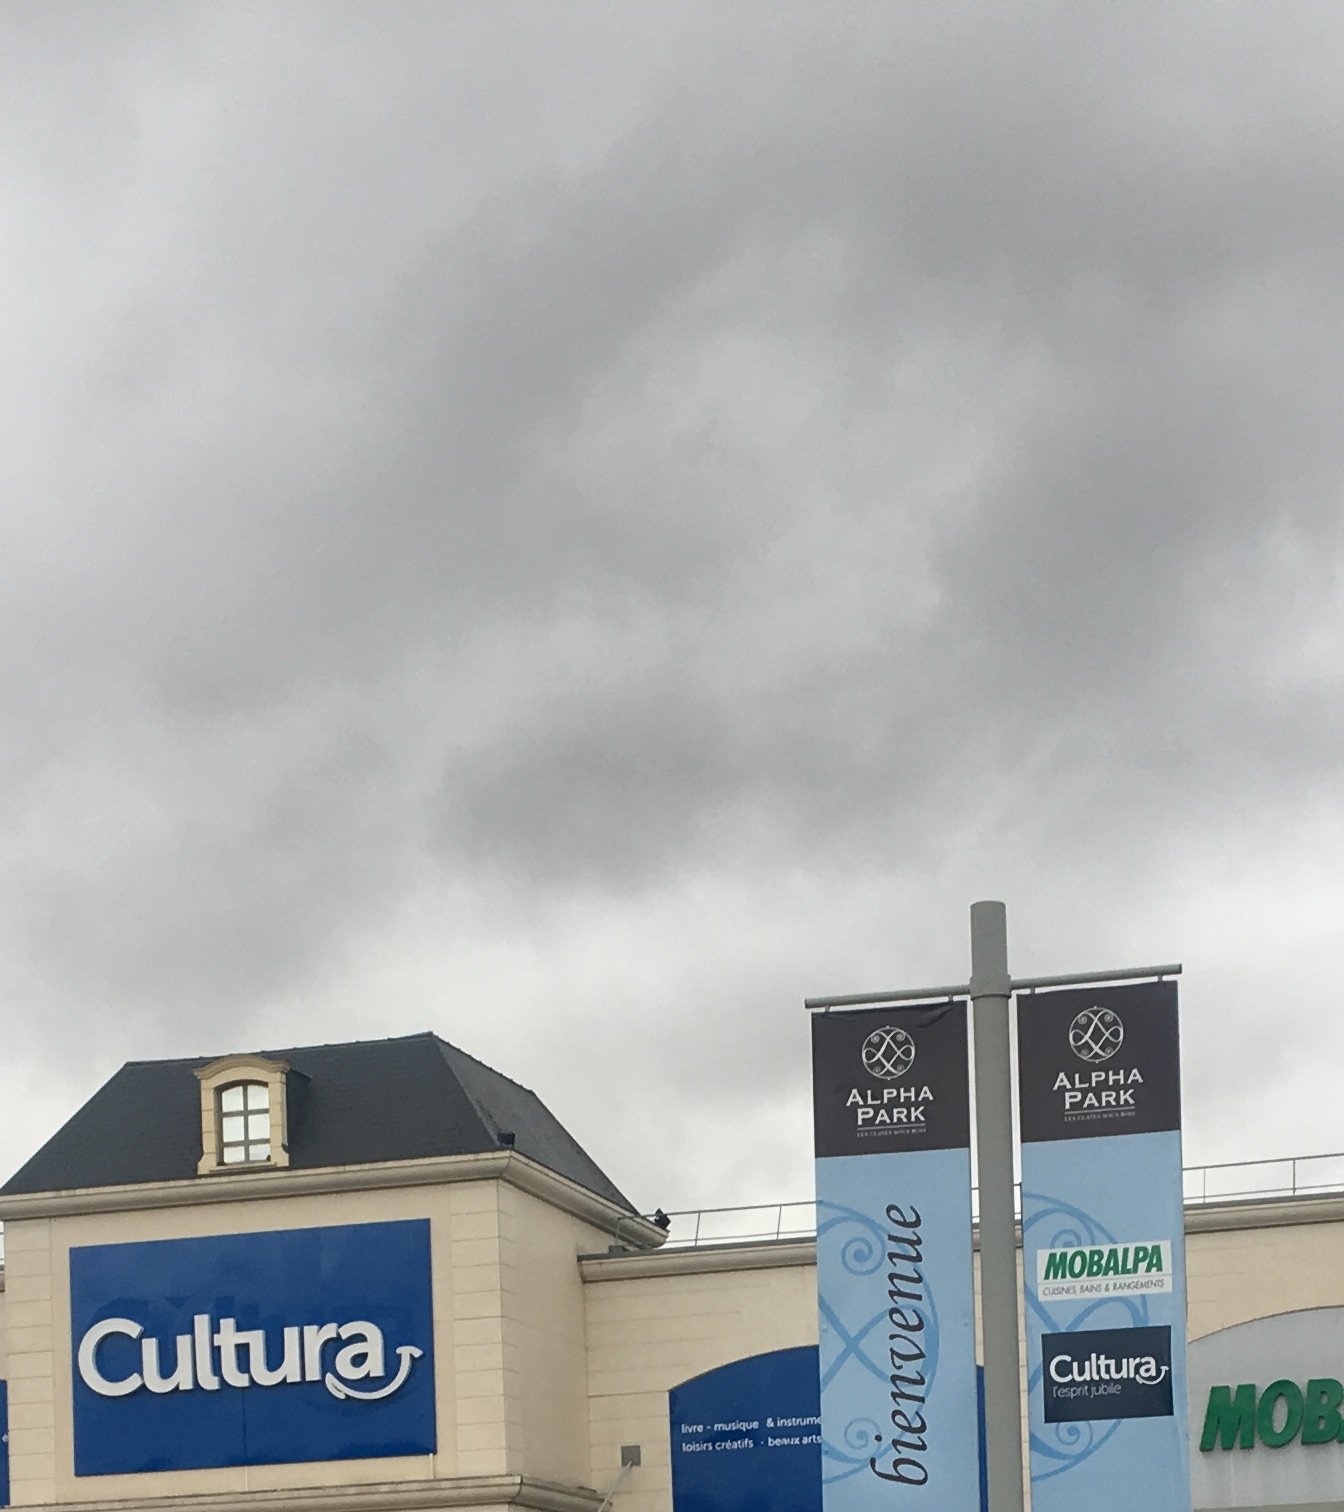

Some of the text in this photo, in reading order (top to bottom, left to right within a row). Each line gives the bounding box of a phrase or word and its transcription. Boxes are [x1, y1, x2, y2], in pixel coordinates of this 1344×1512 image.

[1053, 1068, 1144, 1091] ALPHA
[846, 1085, 934, 1107] ALPHA
[1064, 1089, 1136, 1110] PARK
[857, 1105, 926, 1126] PARK
[1044, 1244, 1163, 1281] MOBALPA
[1113, 1279, 1165, 1291] RANGEMENTS
[870, 1203, 929, 1486] bienvenue
[77, 1313, 391, 1400] Cultura
[1049, 1352, 1159, 1384] Cultura
[681, 1422, 704, 1434] livre
[713, 1419, 759, 1432] musique
[765, 1417, 775, 1428] &
[681, 1441, 714, 1453] loisirs
[714, 1437, 755, 1451] créatifs
[767, 1436, 800, 1448] beaux
[801, 1434, 824, 1445] arts
